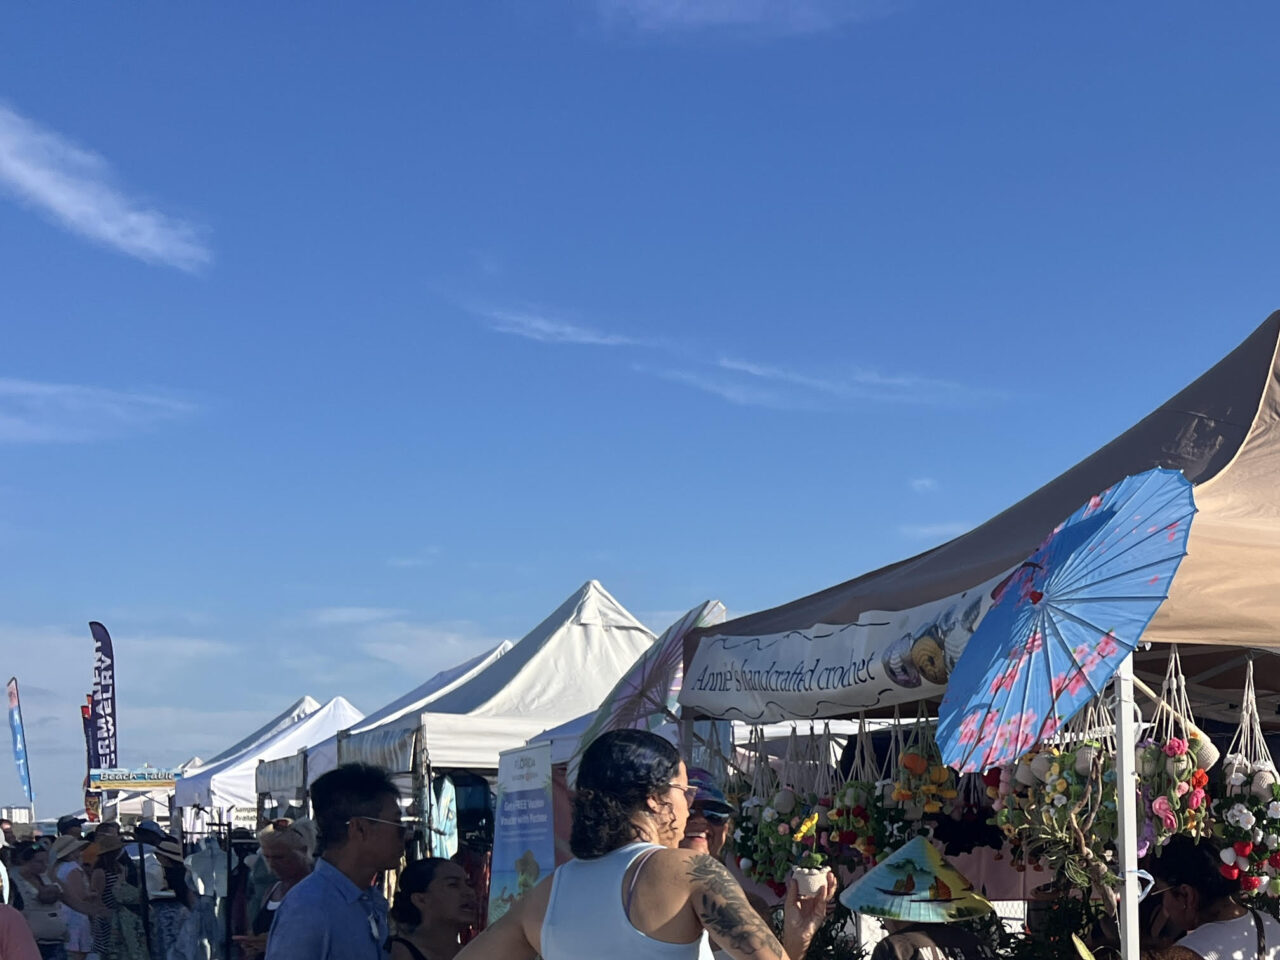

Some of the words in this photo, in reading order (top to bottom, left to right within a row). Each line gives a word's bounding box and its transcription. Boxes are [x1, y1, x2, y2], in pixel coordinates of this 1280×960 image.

[691, 661, 741, 691] Annie's
[741, 658, 820, 692] handcrafted
[817, 648, 875, 690] crochet
[100, 772, 137, 781] Beach
